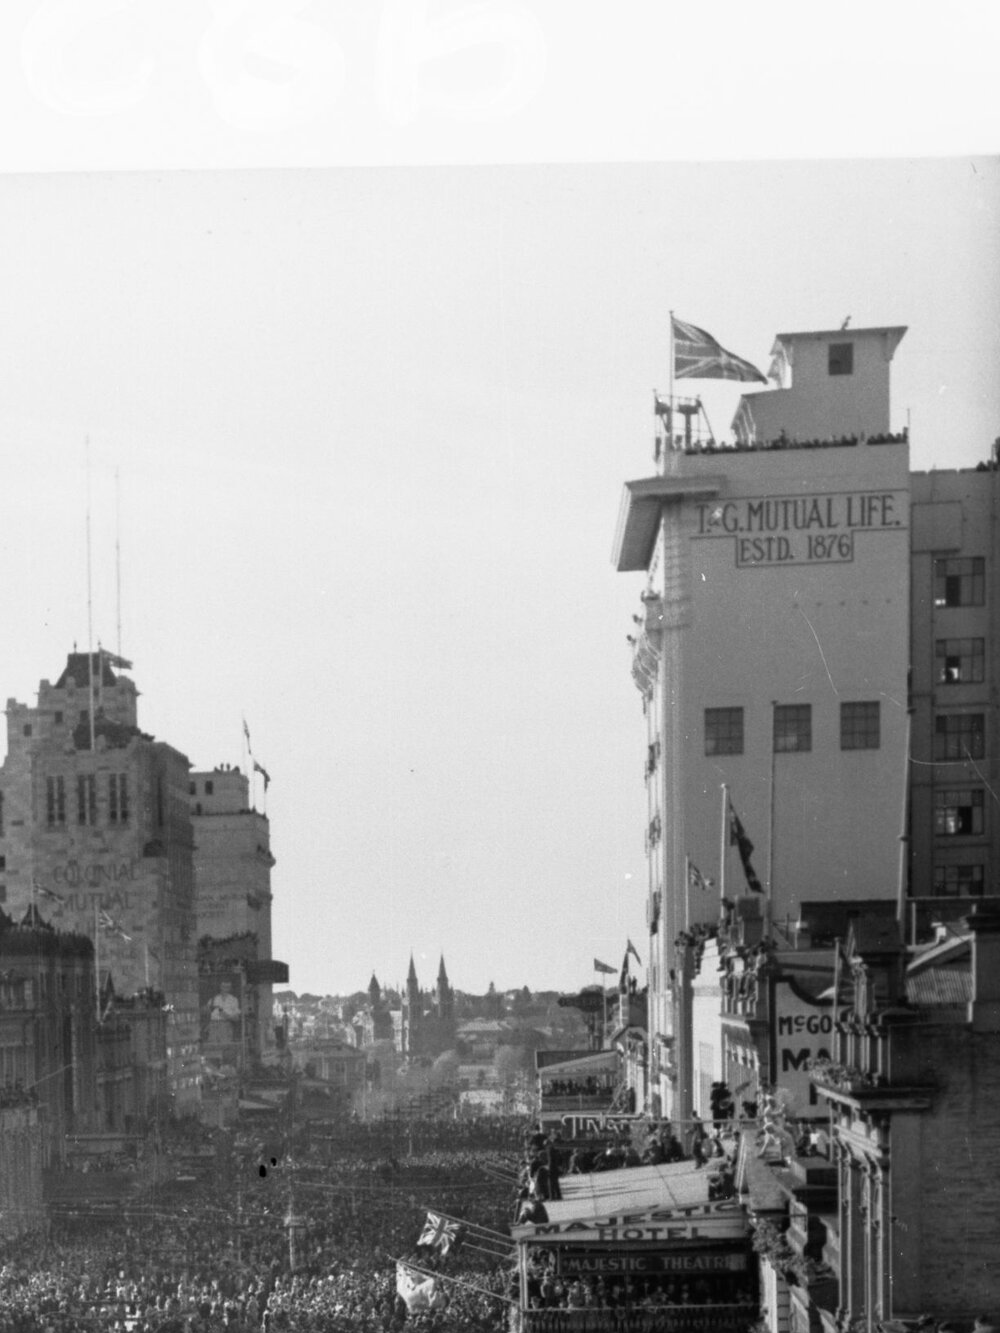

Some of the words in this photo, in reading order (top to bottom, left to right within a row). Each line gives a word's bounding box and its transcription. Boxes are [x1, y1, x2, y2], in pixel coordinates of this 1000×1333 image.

[747, 497, 837, 531] MUTUAL
[847, 494, 900, 527] LIFE.
[739, 537, 794, 562] ESTD.
[808, 533, 850, 559] 1876
[52, 862, 138, 885] COLONIAL
[63, 890, 135, 911] MUTUAL
[778, 1014, 833, 1036] McGO
[534, 1201, 738, 1236] MAJESTIC
[598, 1227, 708, 1241] HOTEL
[567, 1256, 647, 1271] MAJESTIC
